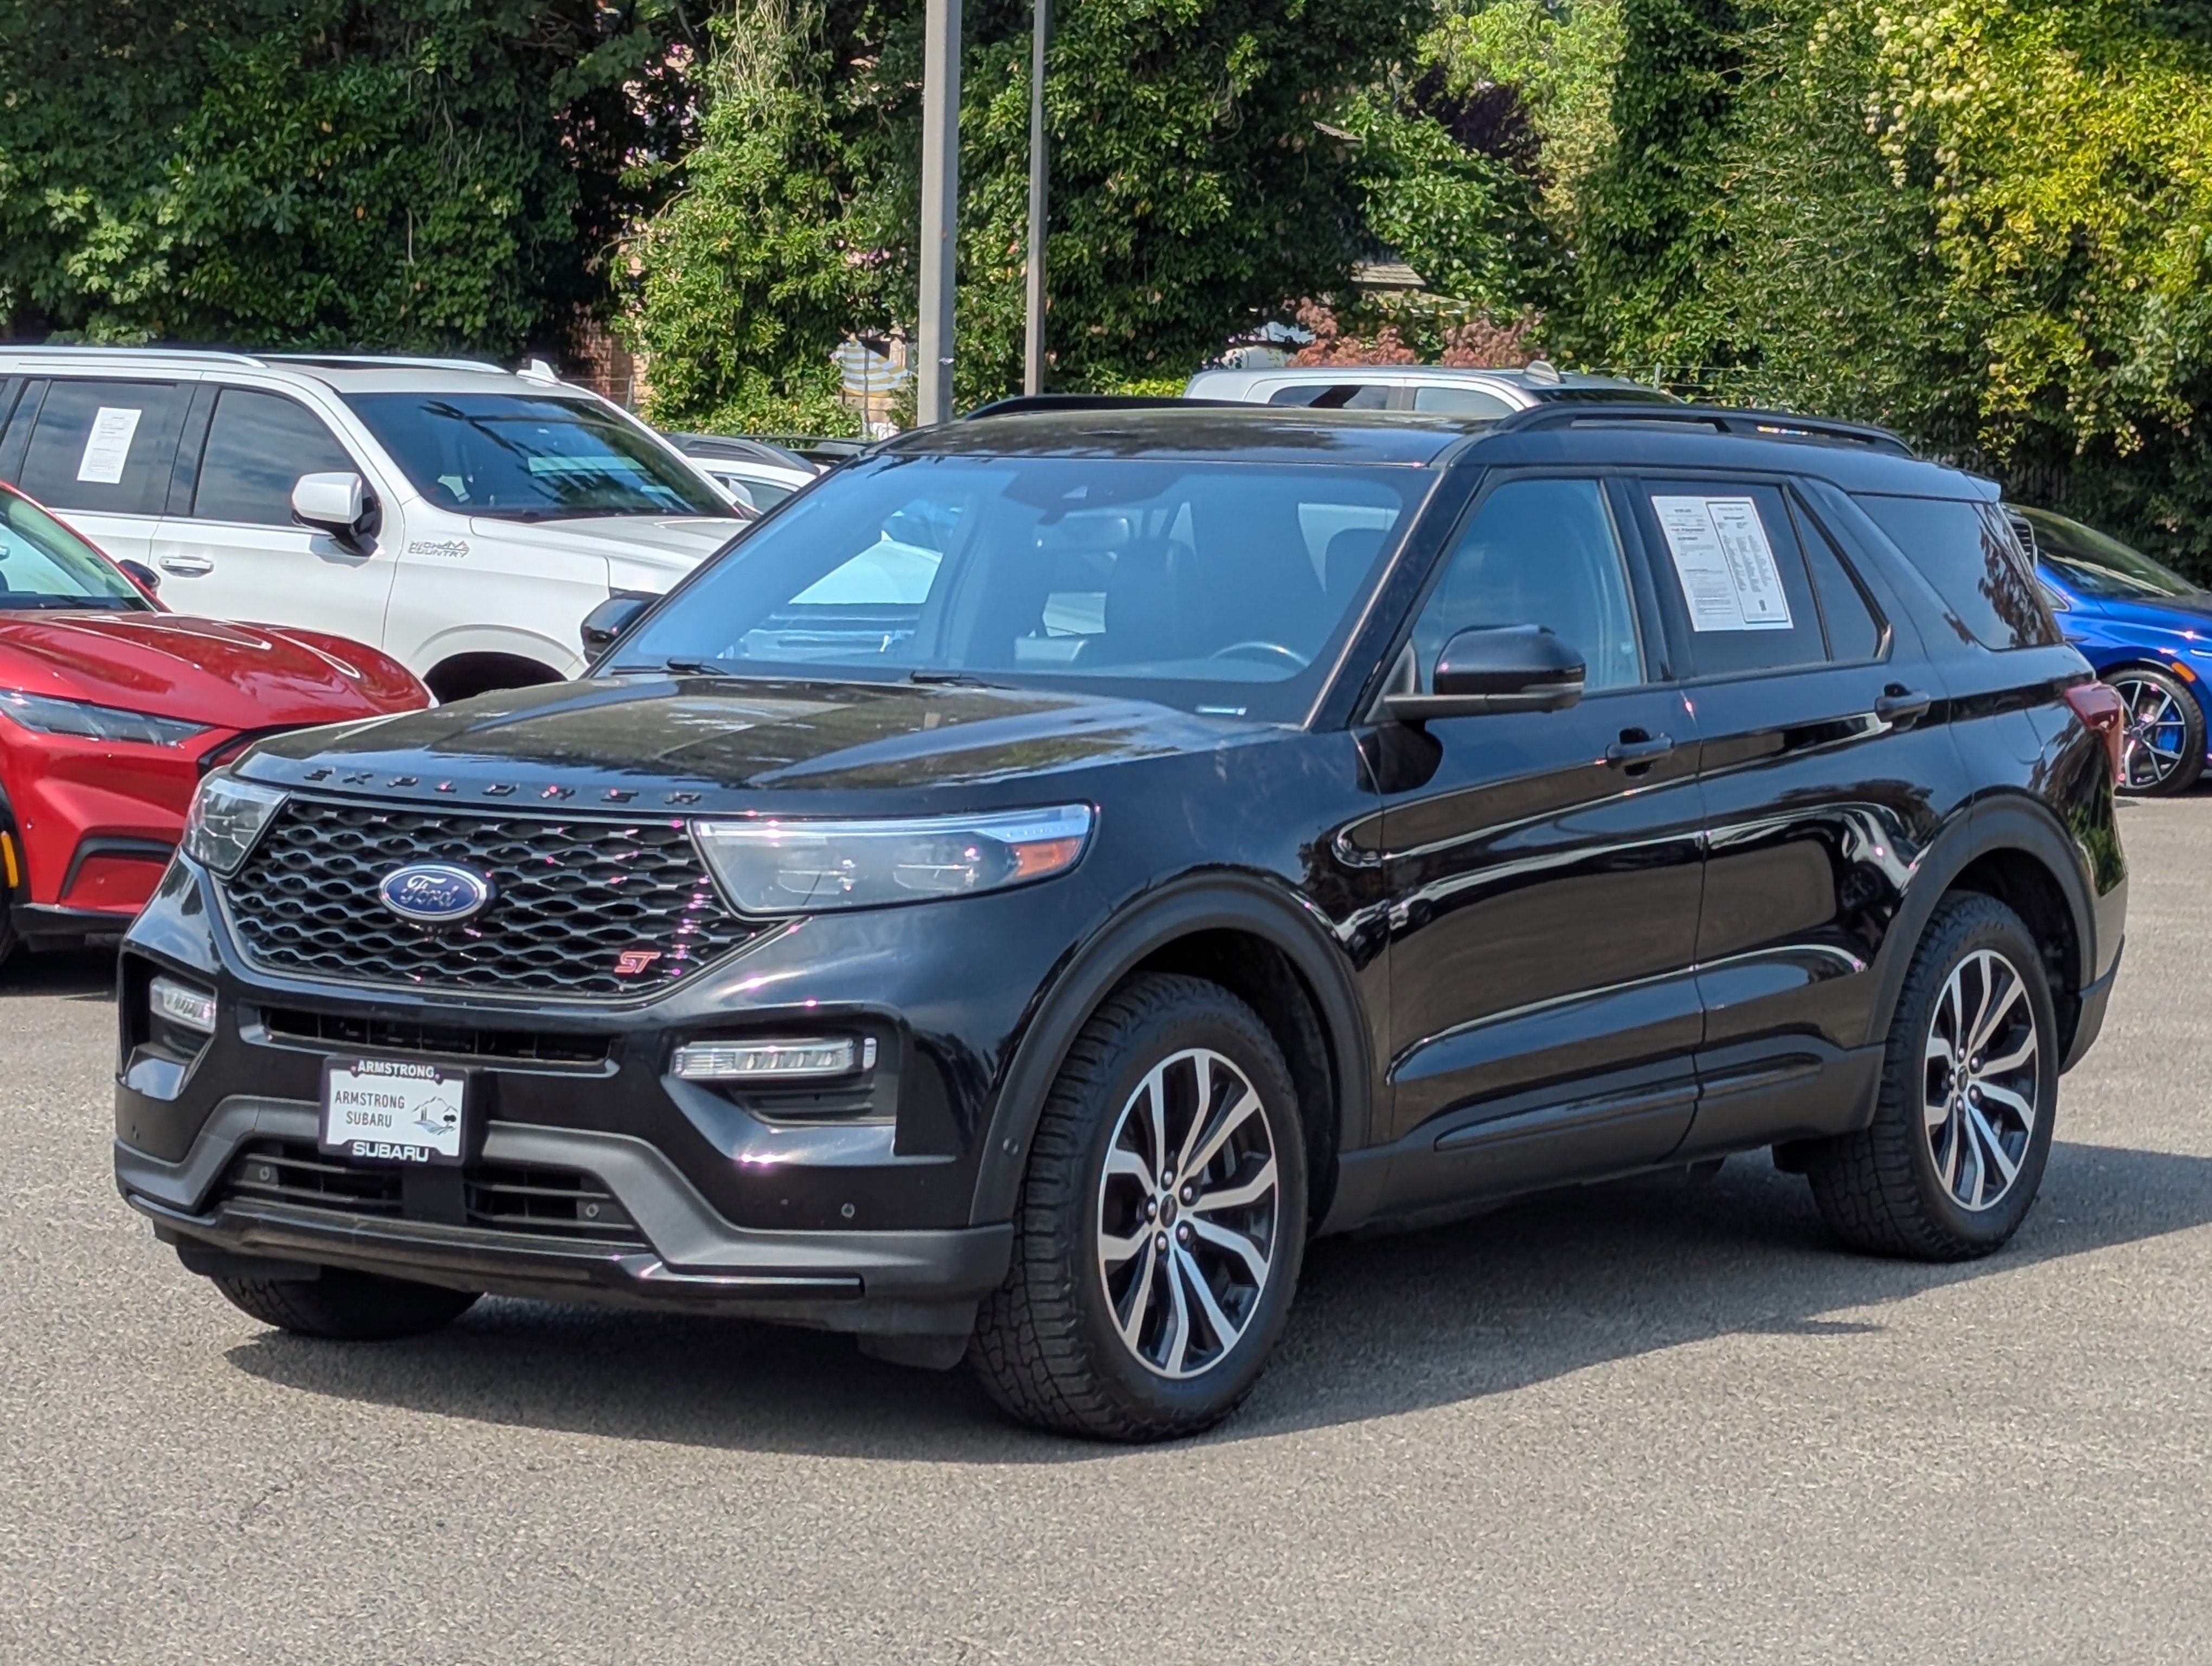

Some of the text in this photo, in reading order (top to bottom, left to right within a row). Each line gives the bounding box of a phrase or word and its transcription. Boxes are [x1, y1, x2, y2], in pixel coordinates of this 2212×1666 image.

[408, 548, 468, 558] COUNTRY
[400, 874, 459, 908] Ford
[613, 951, 661, 973] ST
[357, 1060, 434, 1077] ARMSTRONG
[335, 1091, 405, 1109] ARMSTRONG
[346, 1111, 392, 1127] SUBARU
[352, 1142, 429, 1162] SUBARU
